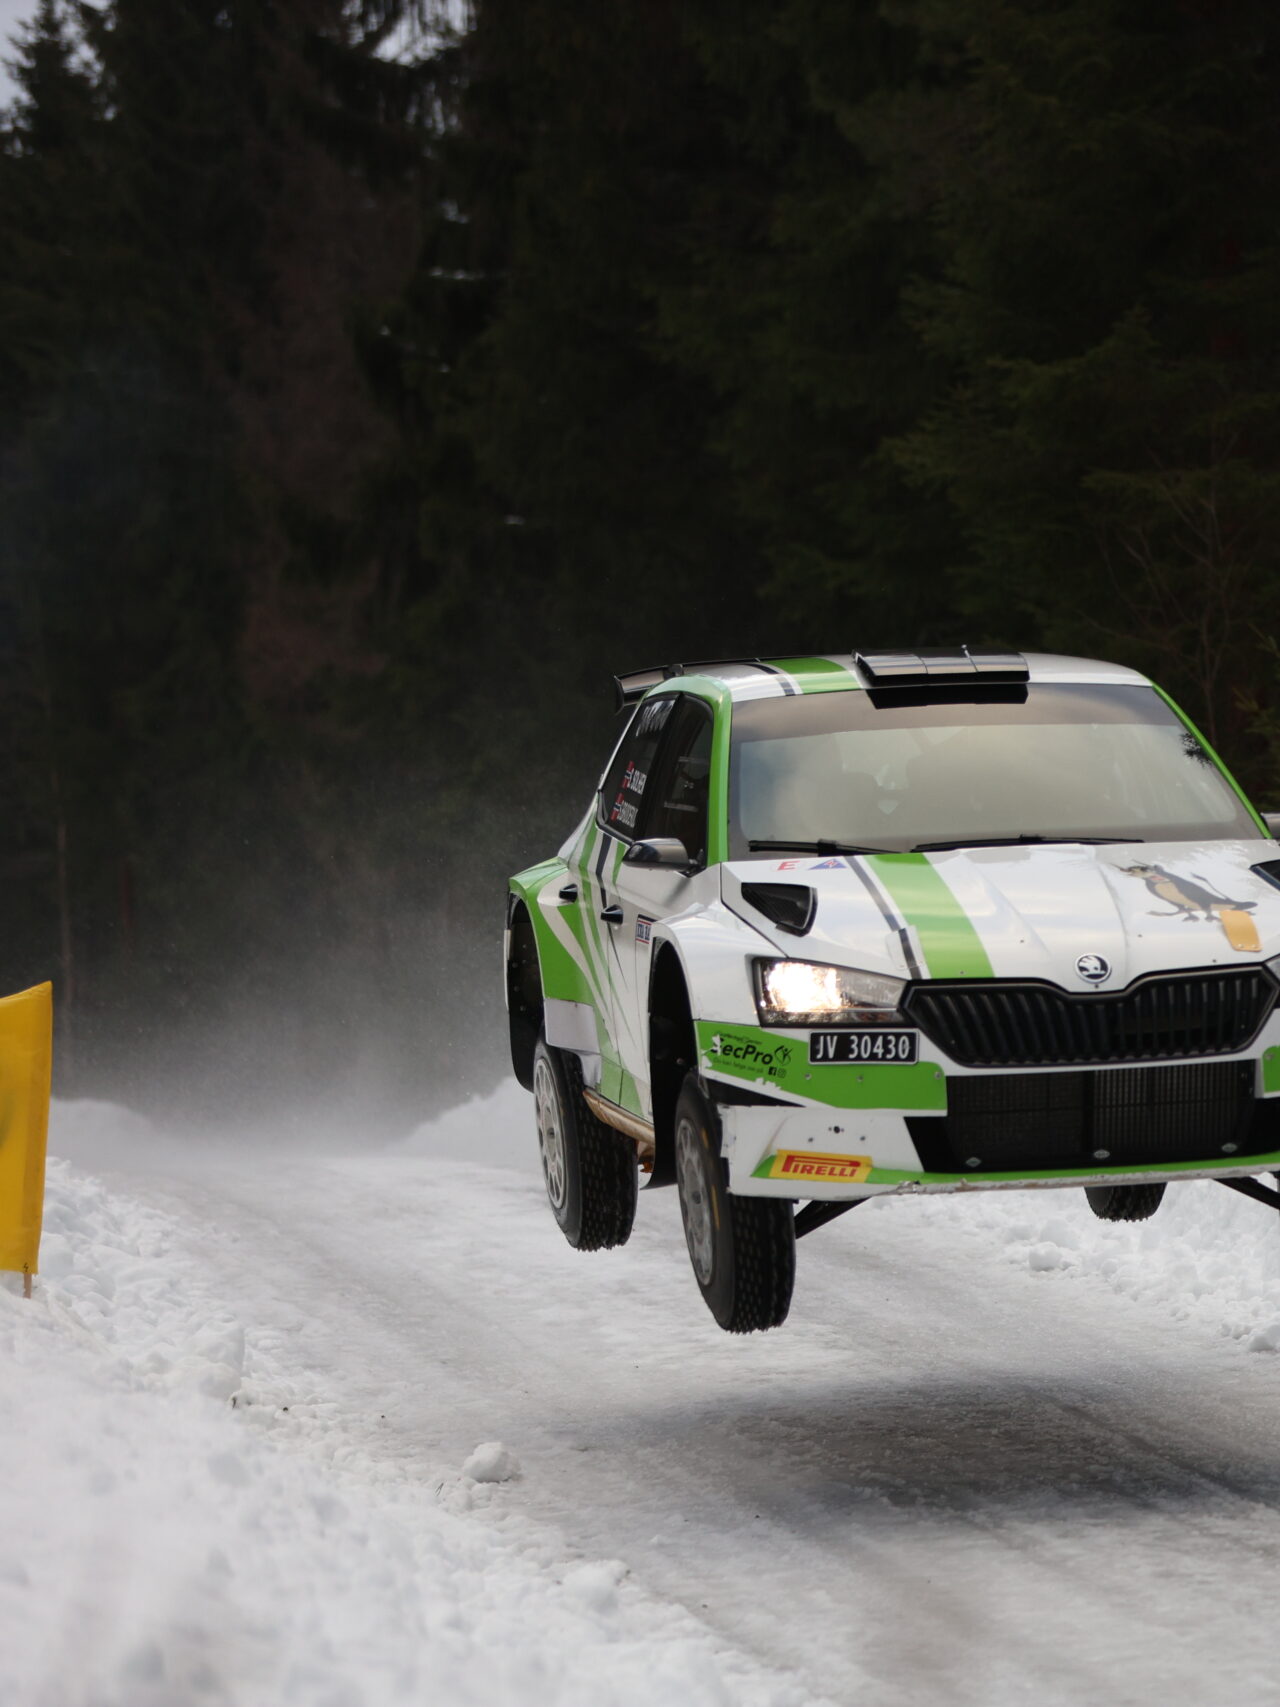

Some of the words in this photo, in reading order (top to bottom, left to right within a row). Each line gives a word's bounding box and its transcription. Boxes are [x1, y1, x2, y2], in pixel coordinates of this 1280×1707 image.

[816, 1035, 838, 1059] JV
[848, 1035, 910, 1059] 30430
[782, 1155, 861, 1177] PIRELLI
